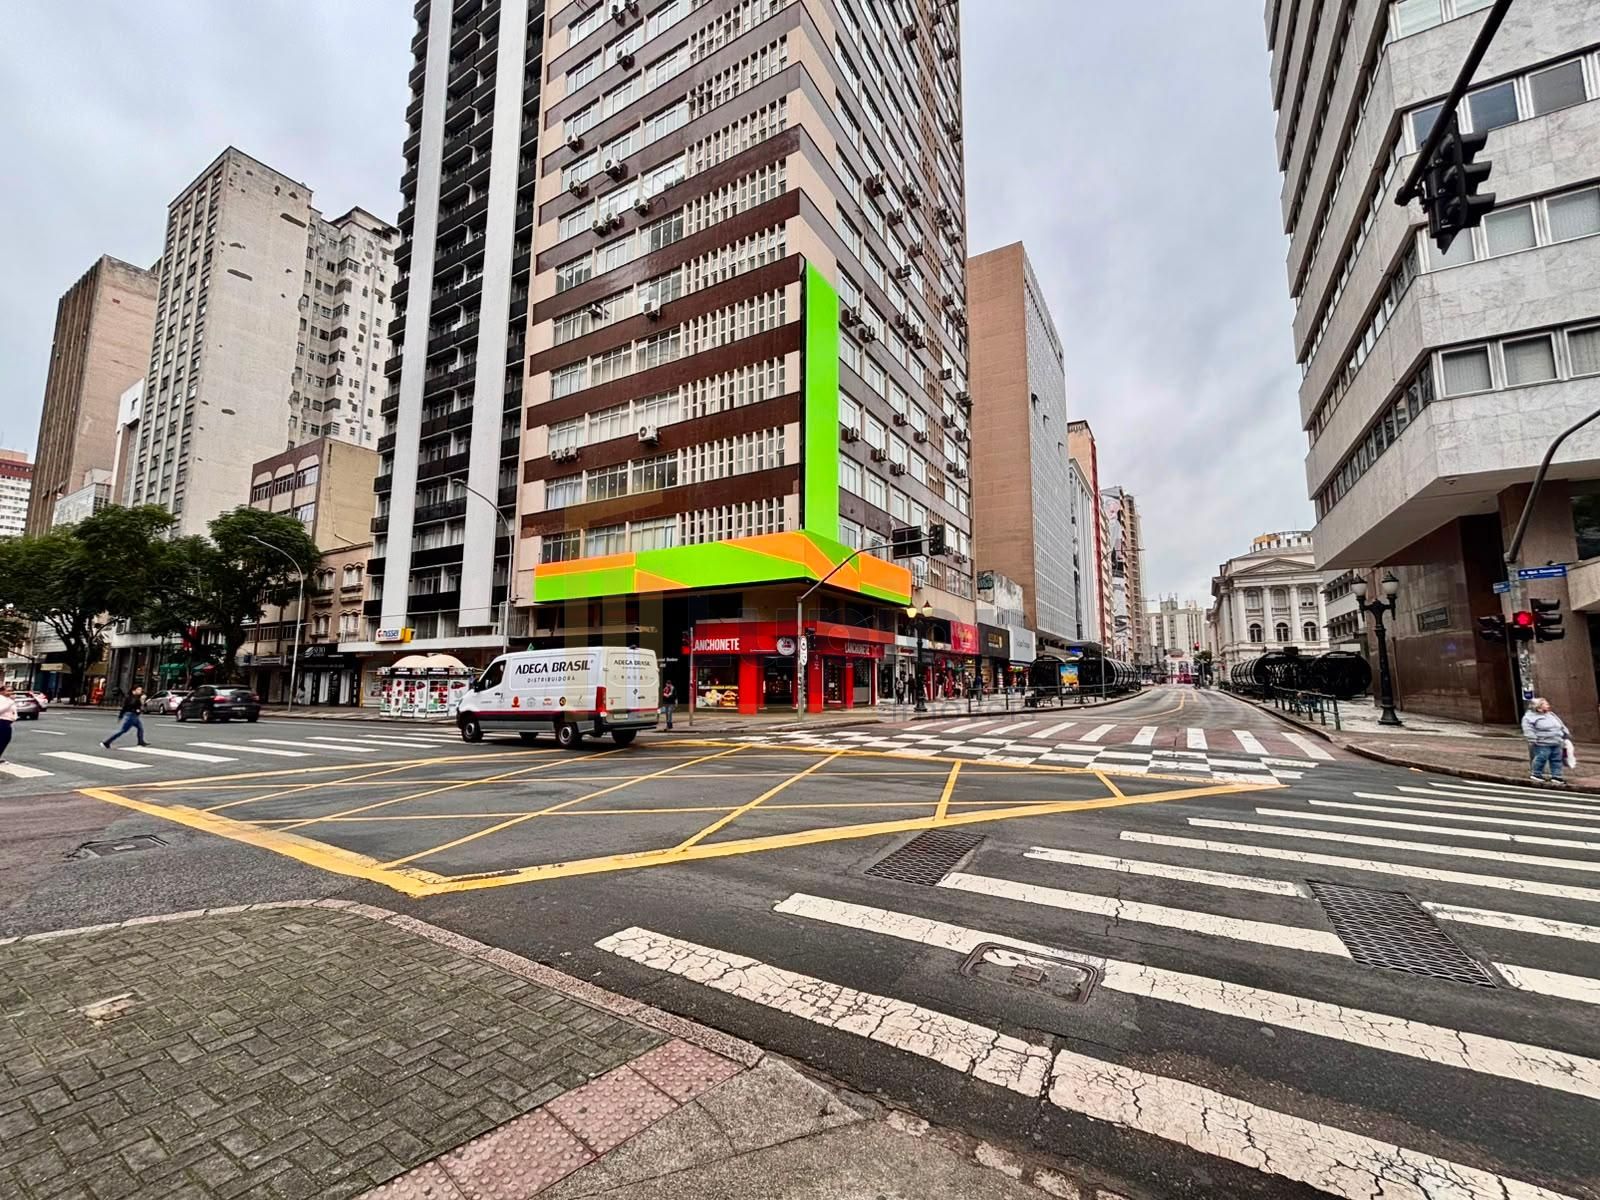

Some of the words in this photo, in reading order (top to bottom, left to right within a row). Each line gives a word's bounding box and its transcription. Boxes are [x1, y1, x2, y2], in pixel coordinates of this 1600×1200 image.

[515, 662, 549, 675] ADEGA
[551, 660, 591, 673] BRASIL
[527, 675, 576, 684] DISTRIBUIDORA
